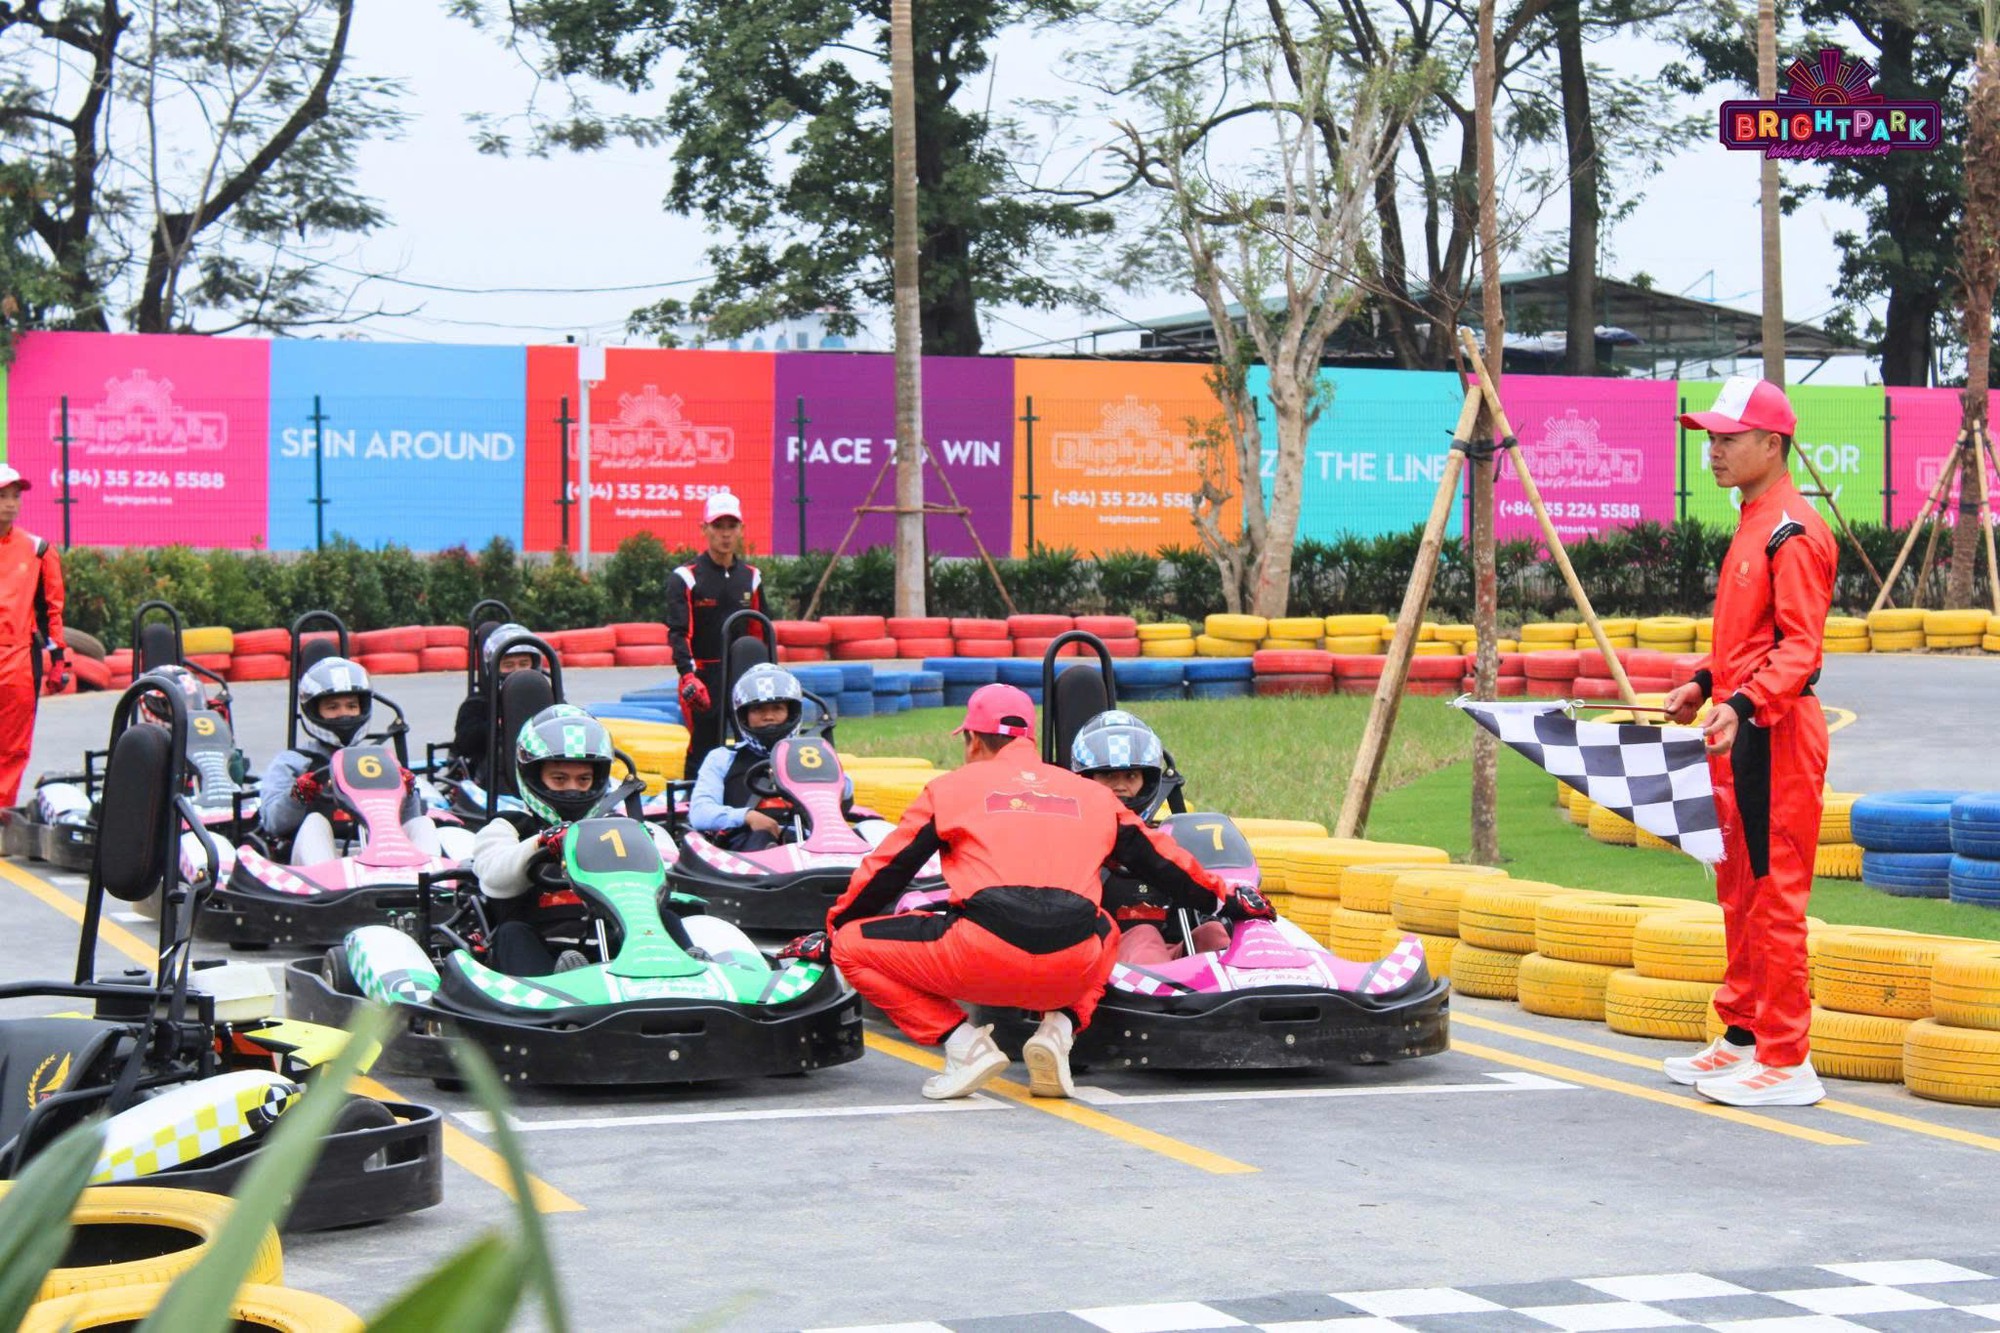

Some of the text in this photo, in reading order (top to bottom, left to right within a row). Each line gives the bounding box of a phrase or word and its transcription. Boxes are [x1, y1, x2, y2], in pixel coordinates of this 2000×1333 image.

[281, 427, 516, 462] SPIN AROUND
[786, 435, 872, 465] RACE
[941, 439, 1001, 467] WIN
[1314, 450, 1377, 482] THE
[1386, 452, 1451, 483] LINE
[1796, 442, 1861, 475] FOR
[104, 469, 130, 487] 35
[133, 470, 170, 488] 224
[174, 471, 225, 489] 5588
[617, 483, 642, 500] 35
[644, 483, 680, 500] 224
[1100, 491, 1123, 508] 35
[1126, 491, 1159, 508] 224
[1566, 501, 1597, 518] 224
[1600, 503, 1641, 519] 5588
[193, 717, 216, 736] 9
[356, 755, 383, 779] 6
[798, 745, 823, 769] 8
[599, 828, 628, 858] 1
[1195, 823, 1225, 851] 7
